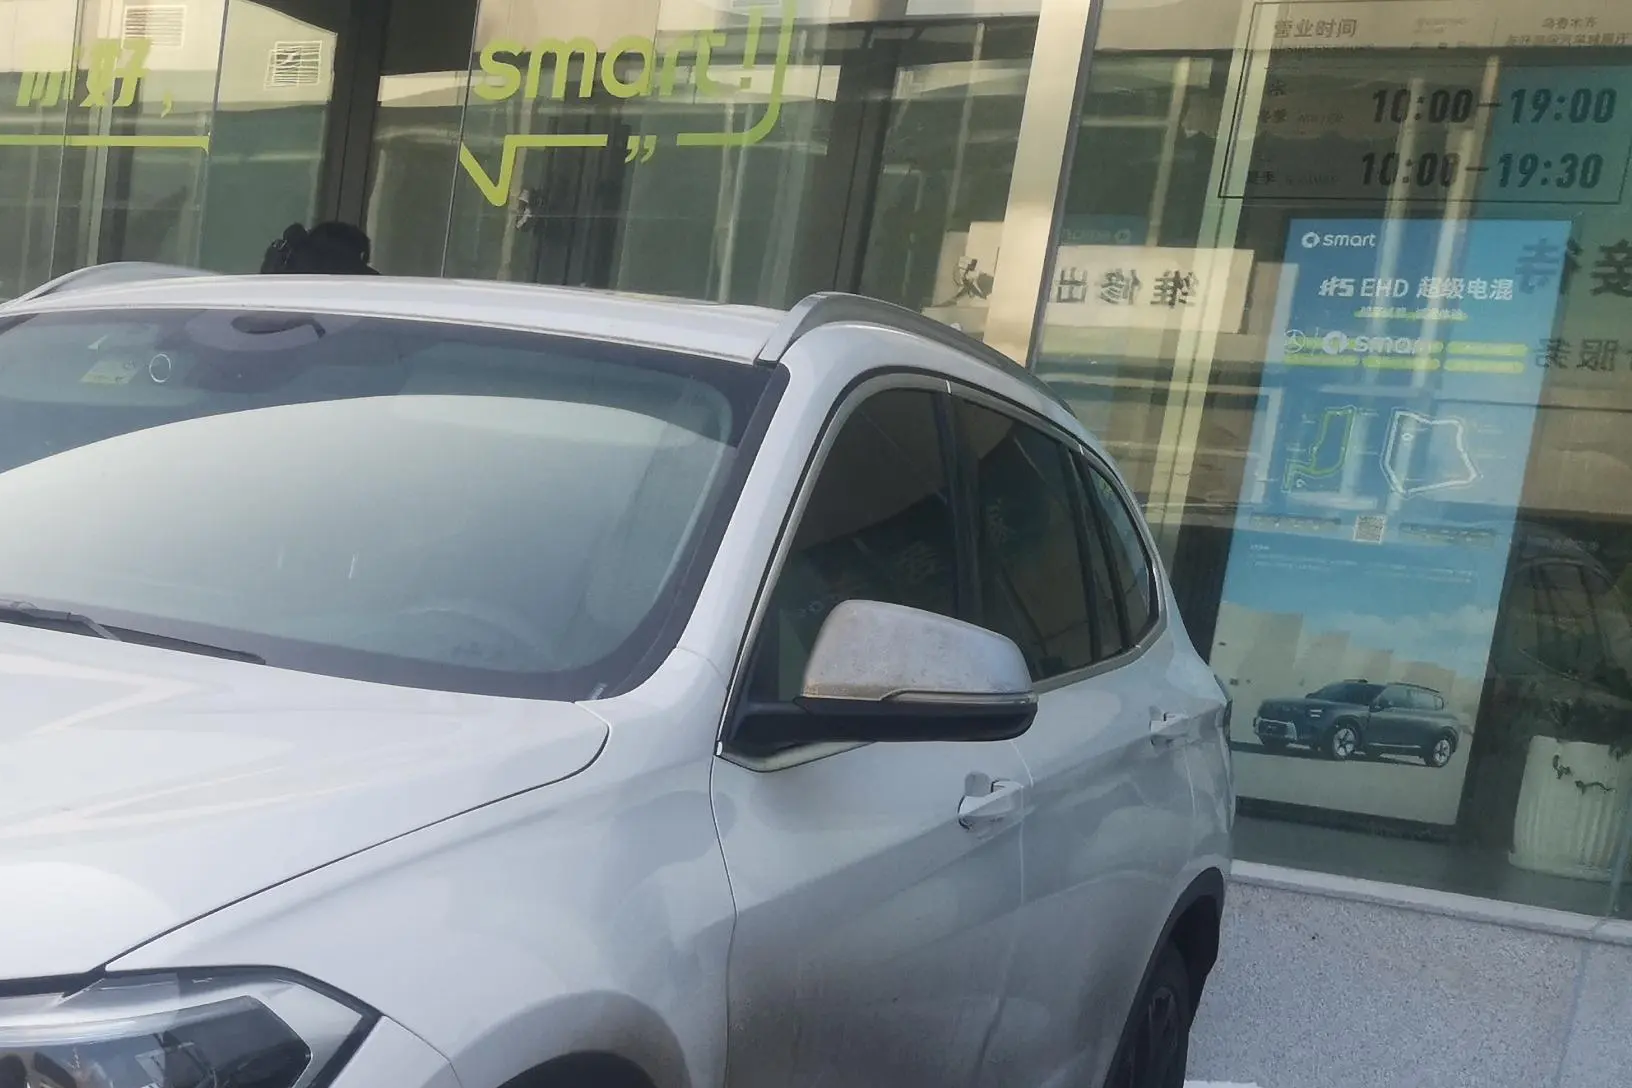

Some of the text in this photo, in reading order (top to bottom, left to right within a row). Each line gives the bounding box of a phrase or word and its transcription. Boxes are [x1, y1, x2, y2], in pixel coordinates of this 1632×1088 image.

[1274, 18, 1358, 39] 营业时间
[1322, 232, 1377, 248] smart
[1360, 279, 1409, 298] EHD
[1416, 277, 1514, 301] 超级电混
